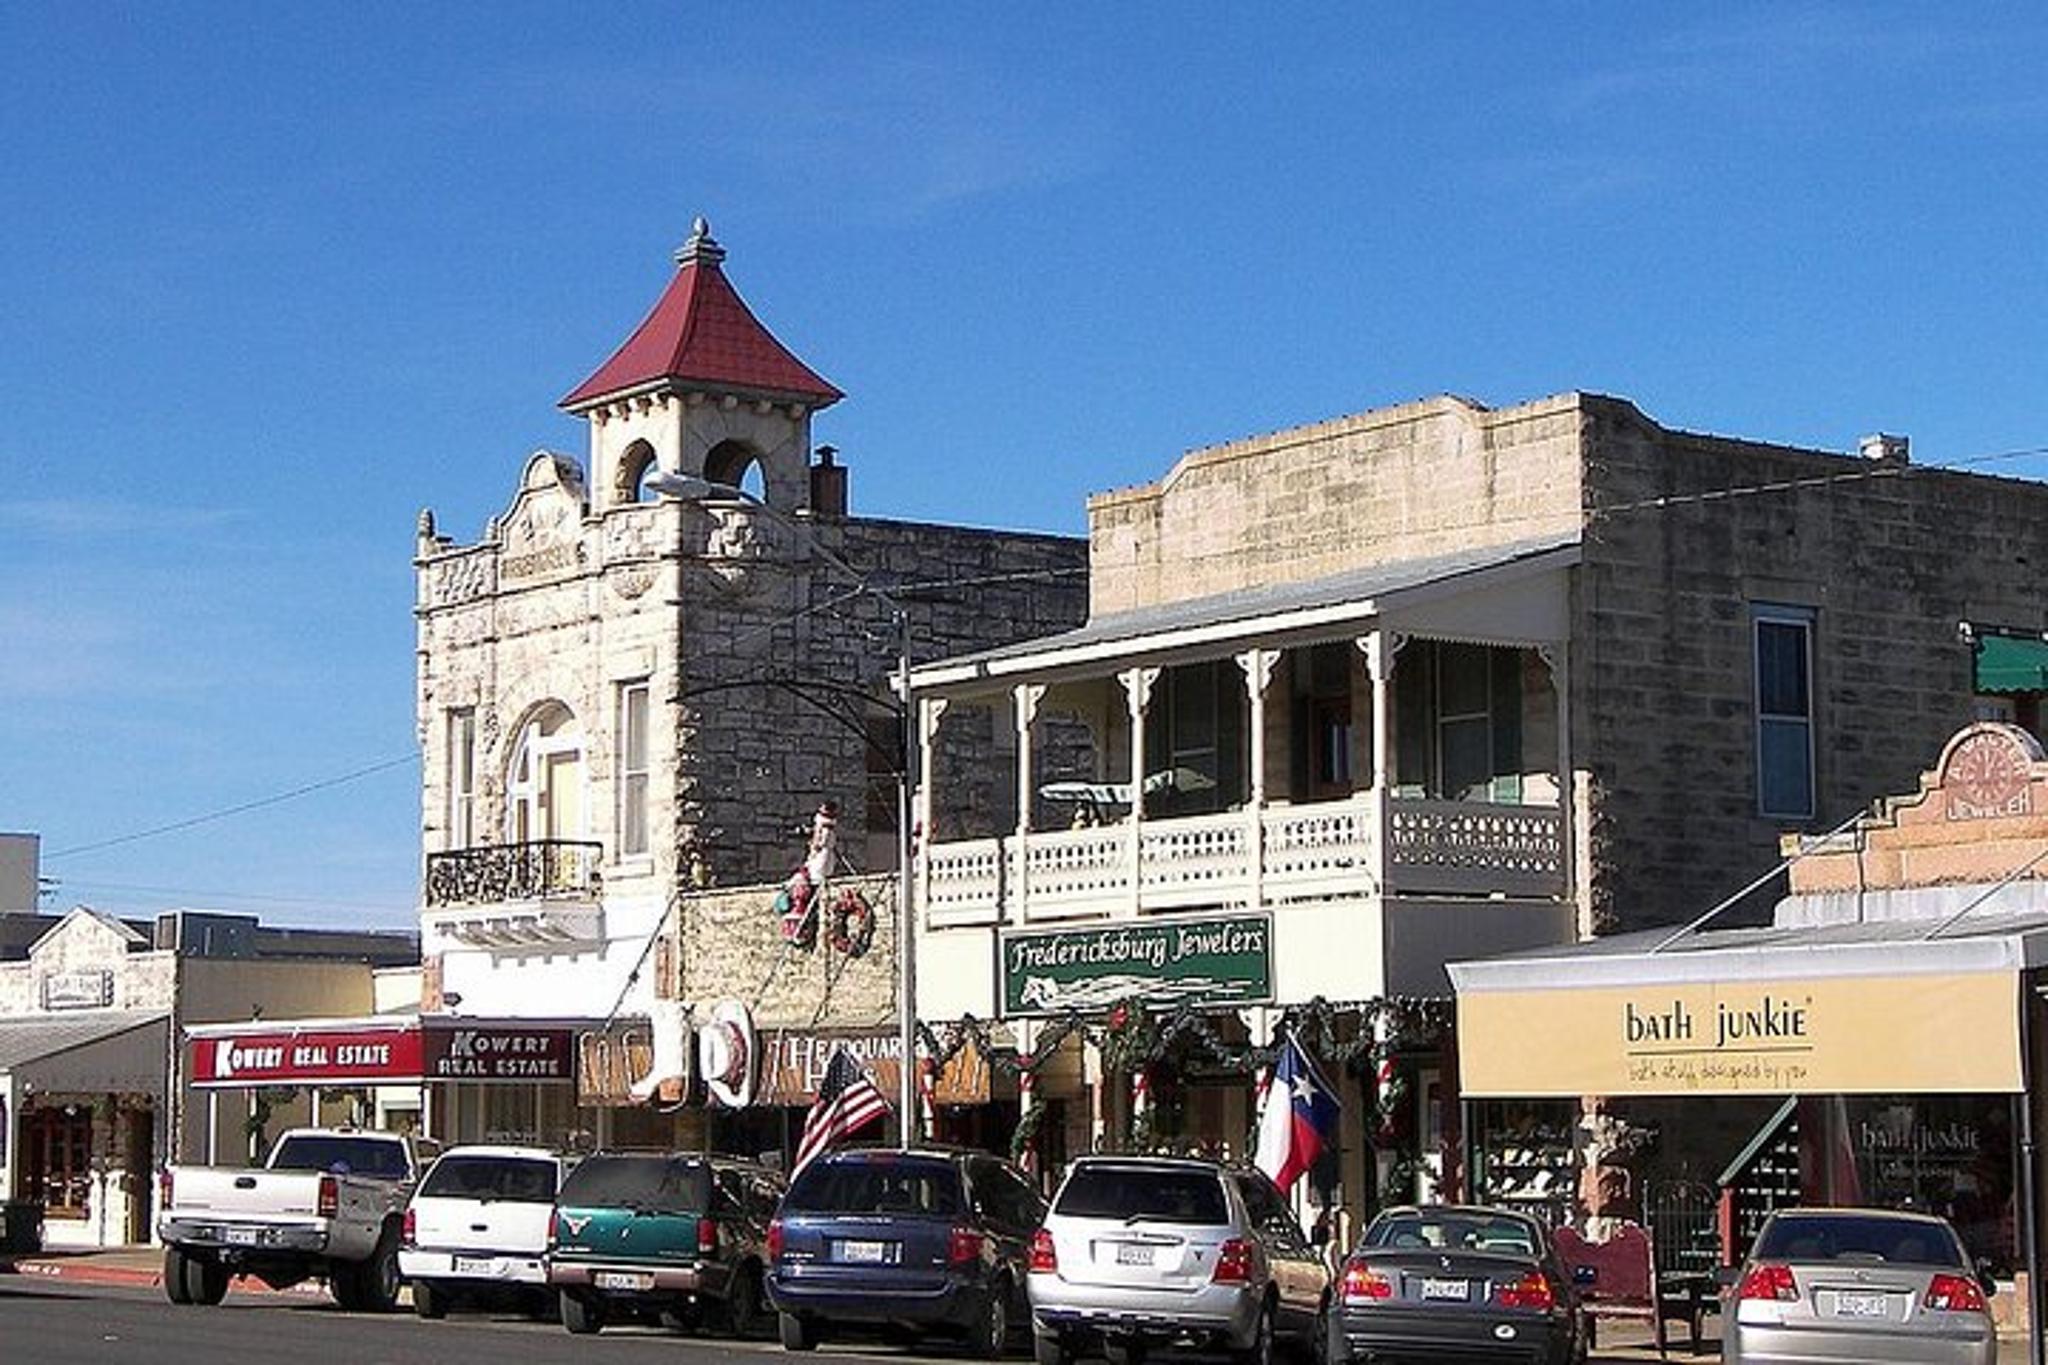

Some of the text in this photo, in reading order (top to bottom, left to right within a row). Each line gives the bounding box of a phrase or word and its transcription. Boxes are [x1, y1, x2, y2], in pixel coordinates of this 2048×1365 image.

[1011, 923, 1264, 974] Fredericksburg Jewelers
[215, 1040, 390, 1078] KOWERT REAL ESTATE
[452, 1031, 550, 1057] KOWERT
[438, 1059, 560, 1076] REAL ESTATE
